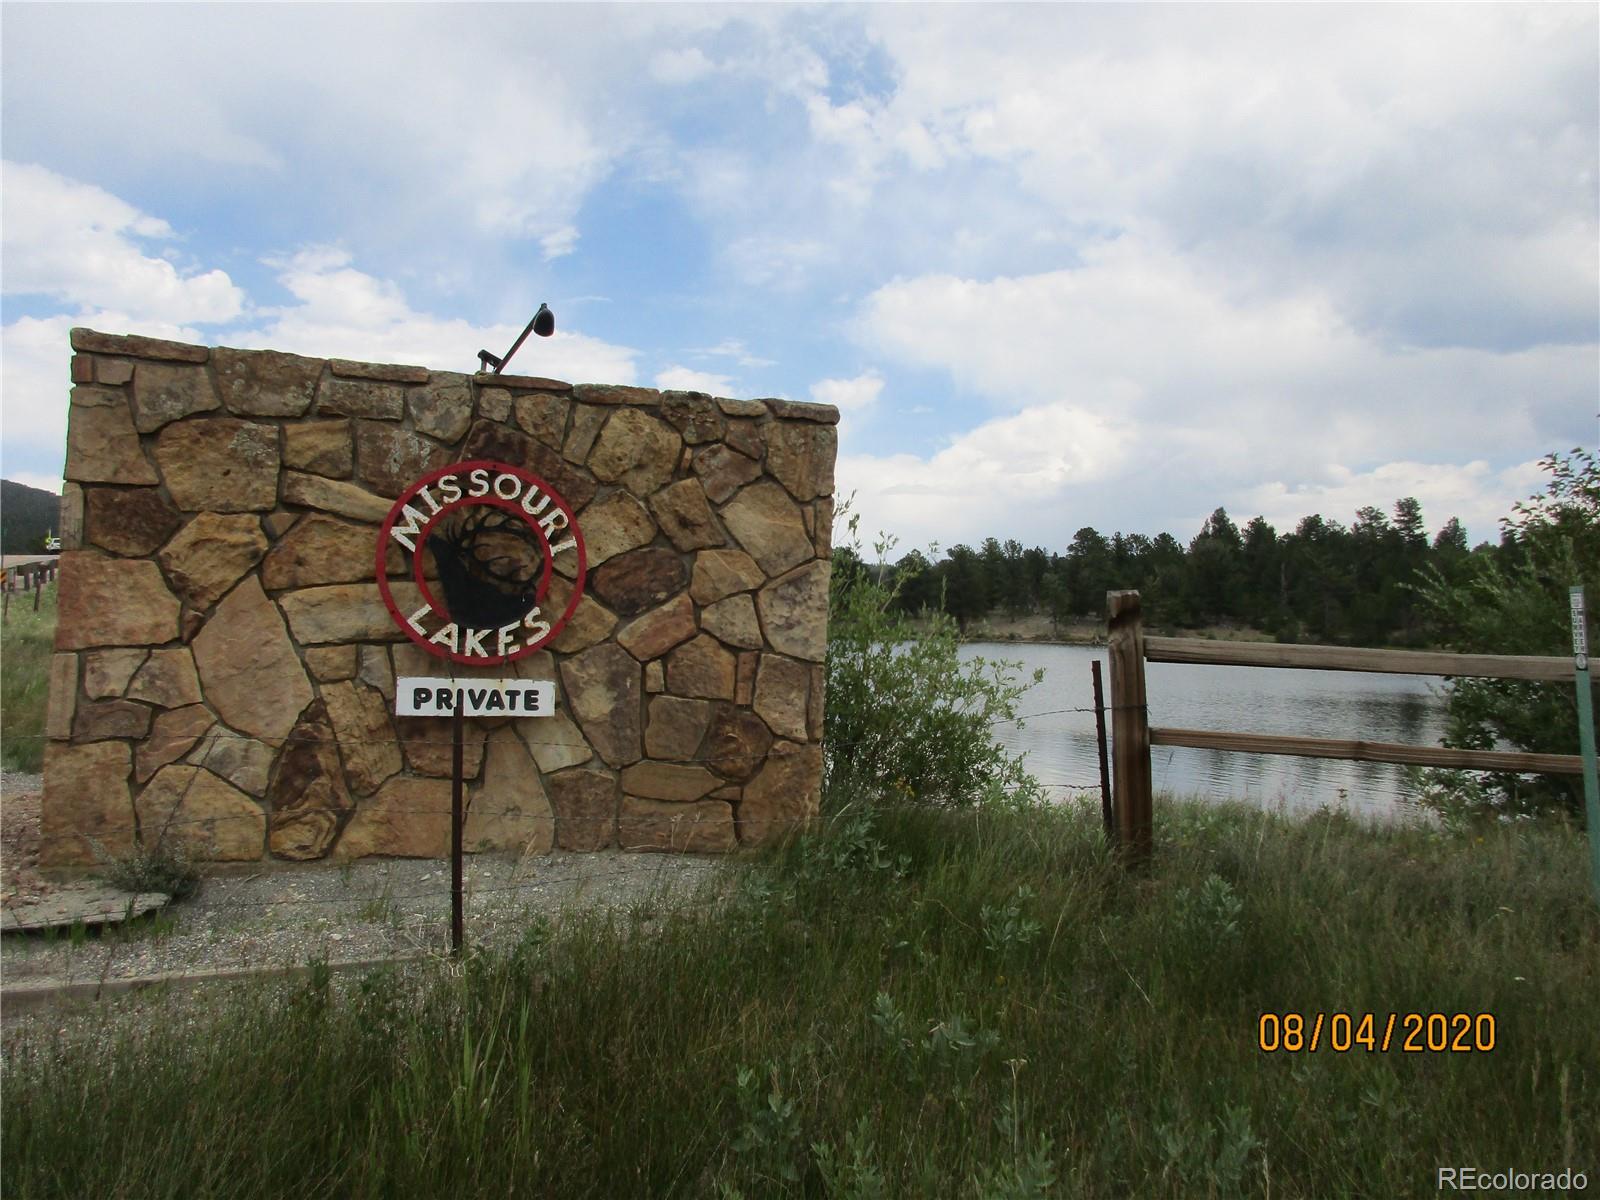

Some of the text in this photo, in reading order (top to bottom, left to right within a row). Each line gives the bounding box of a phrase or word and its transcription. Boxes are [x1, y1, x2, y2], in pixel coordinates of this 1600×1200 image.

[390, 469, 577, 556] MISSOURI
[407, 604, 551, 658] LAKES
[413, 687, 540, 711] PRIVATE
